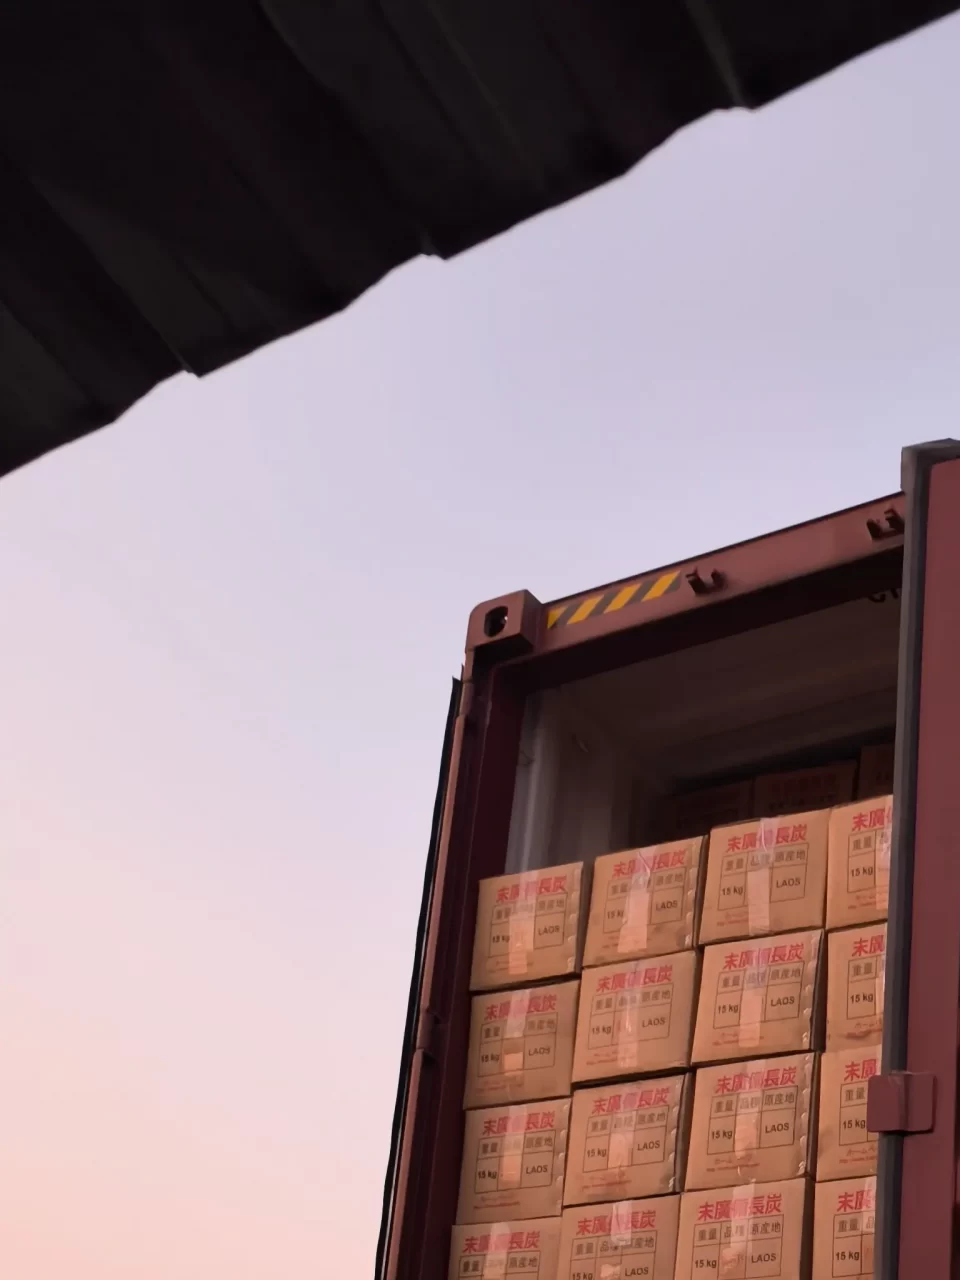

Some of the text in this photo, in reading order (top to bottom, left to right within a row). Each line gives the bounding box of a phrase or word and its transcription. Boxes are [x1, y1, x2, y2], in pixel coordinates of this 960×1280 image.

[850, 866, 873, 877] 15 kg
[850, 993, 874, 1004] 15 kg
[765, 1122, 790, 1134] LAOS
[842, 1119, 866, 1130] 15 kg
[637, 1140, 660, 1151] LAOS
[526, 1165, 548, 1175] LAOS
[751, 1253, 776, 1264] LAOS
[835, 1251, 860, 1261] 15 kg
[694, 1259, 717, 1269] 15 kg
[572, 1272, 581, 1280] 15
[624, 1266, 649, 1277] LAOS
